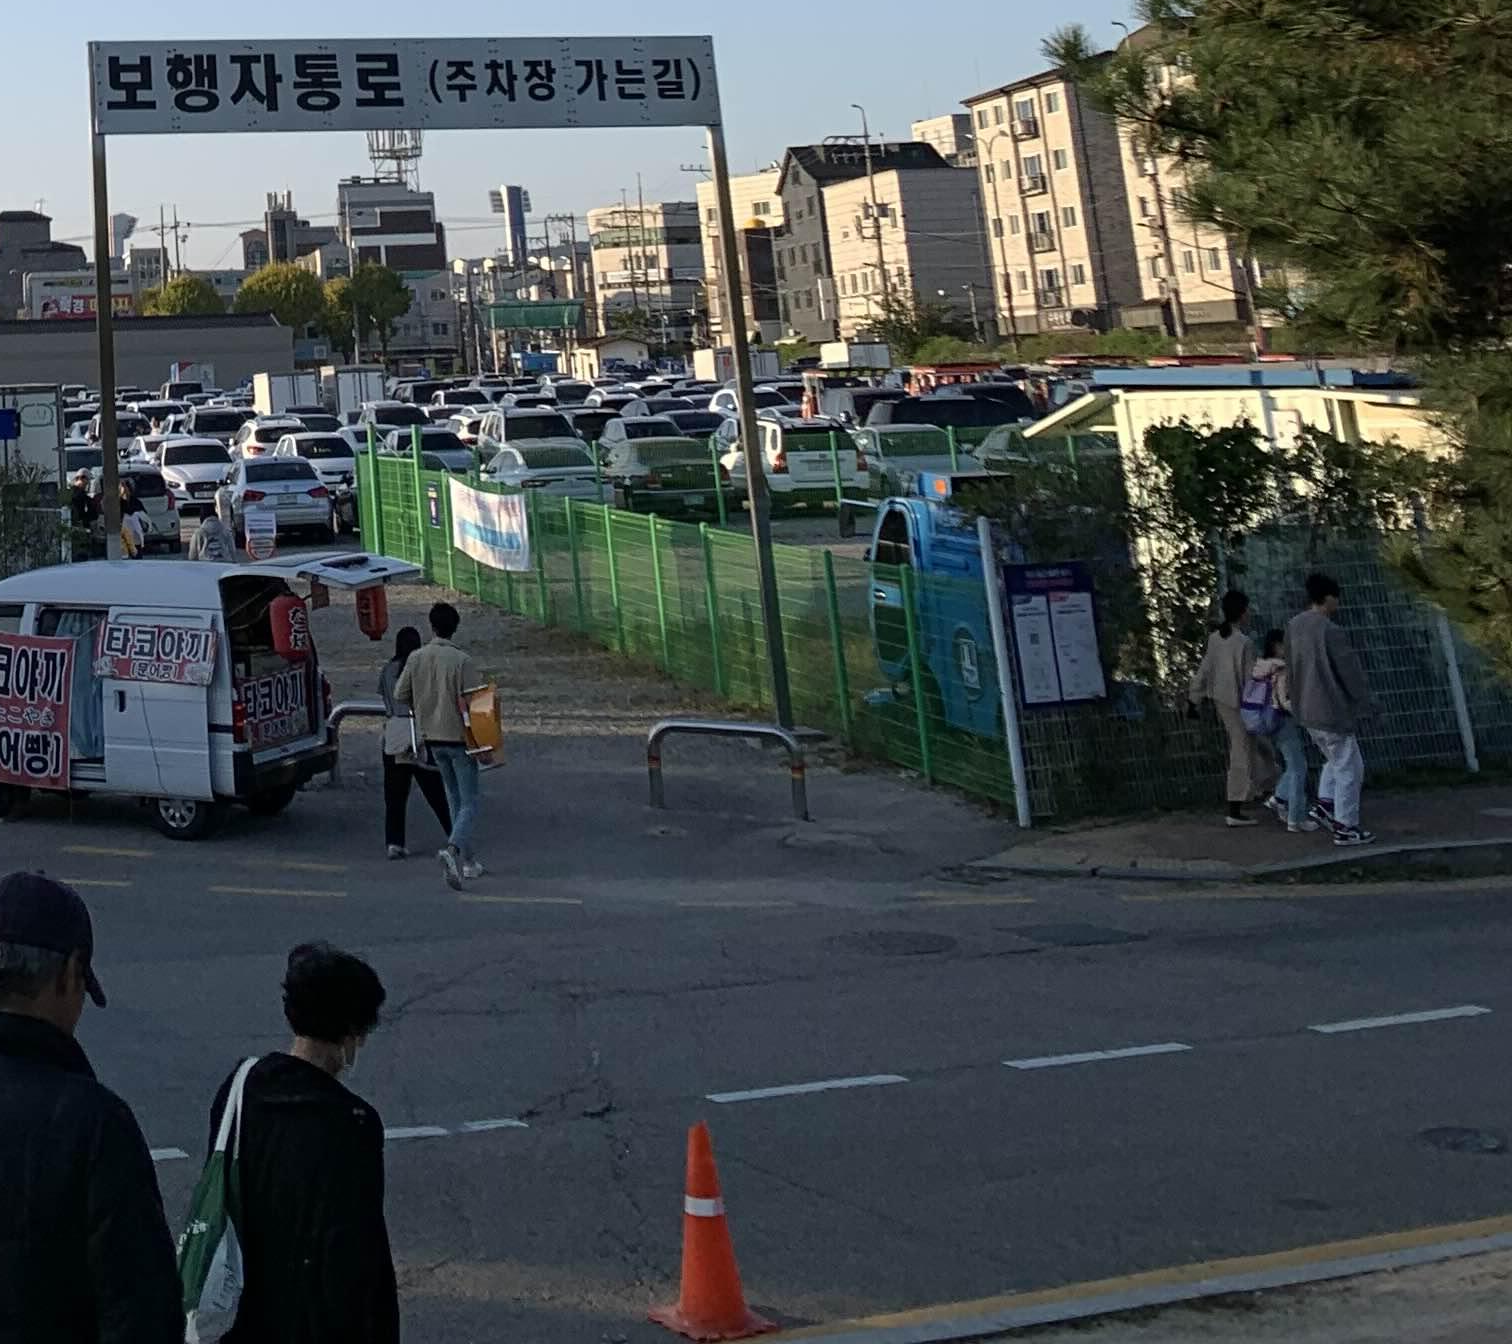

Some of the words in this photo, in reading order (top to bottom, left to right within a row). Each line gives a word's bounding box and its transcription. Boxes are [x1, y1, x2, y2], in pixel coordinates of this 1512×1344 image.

[106, 53, 405, 113] 보행자통로
[429, 59, 557, 104] (주차장
[574, 58, 701, 102] 가는길)
[104, 624, 213, 663] 타코야끼
[243, 669, 305, 724] 타코야끼
